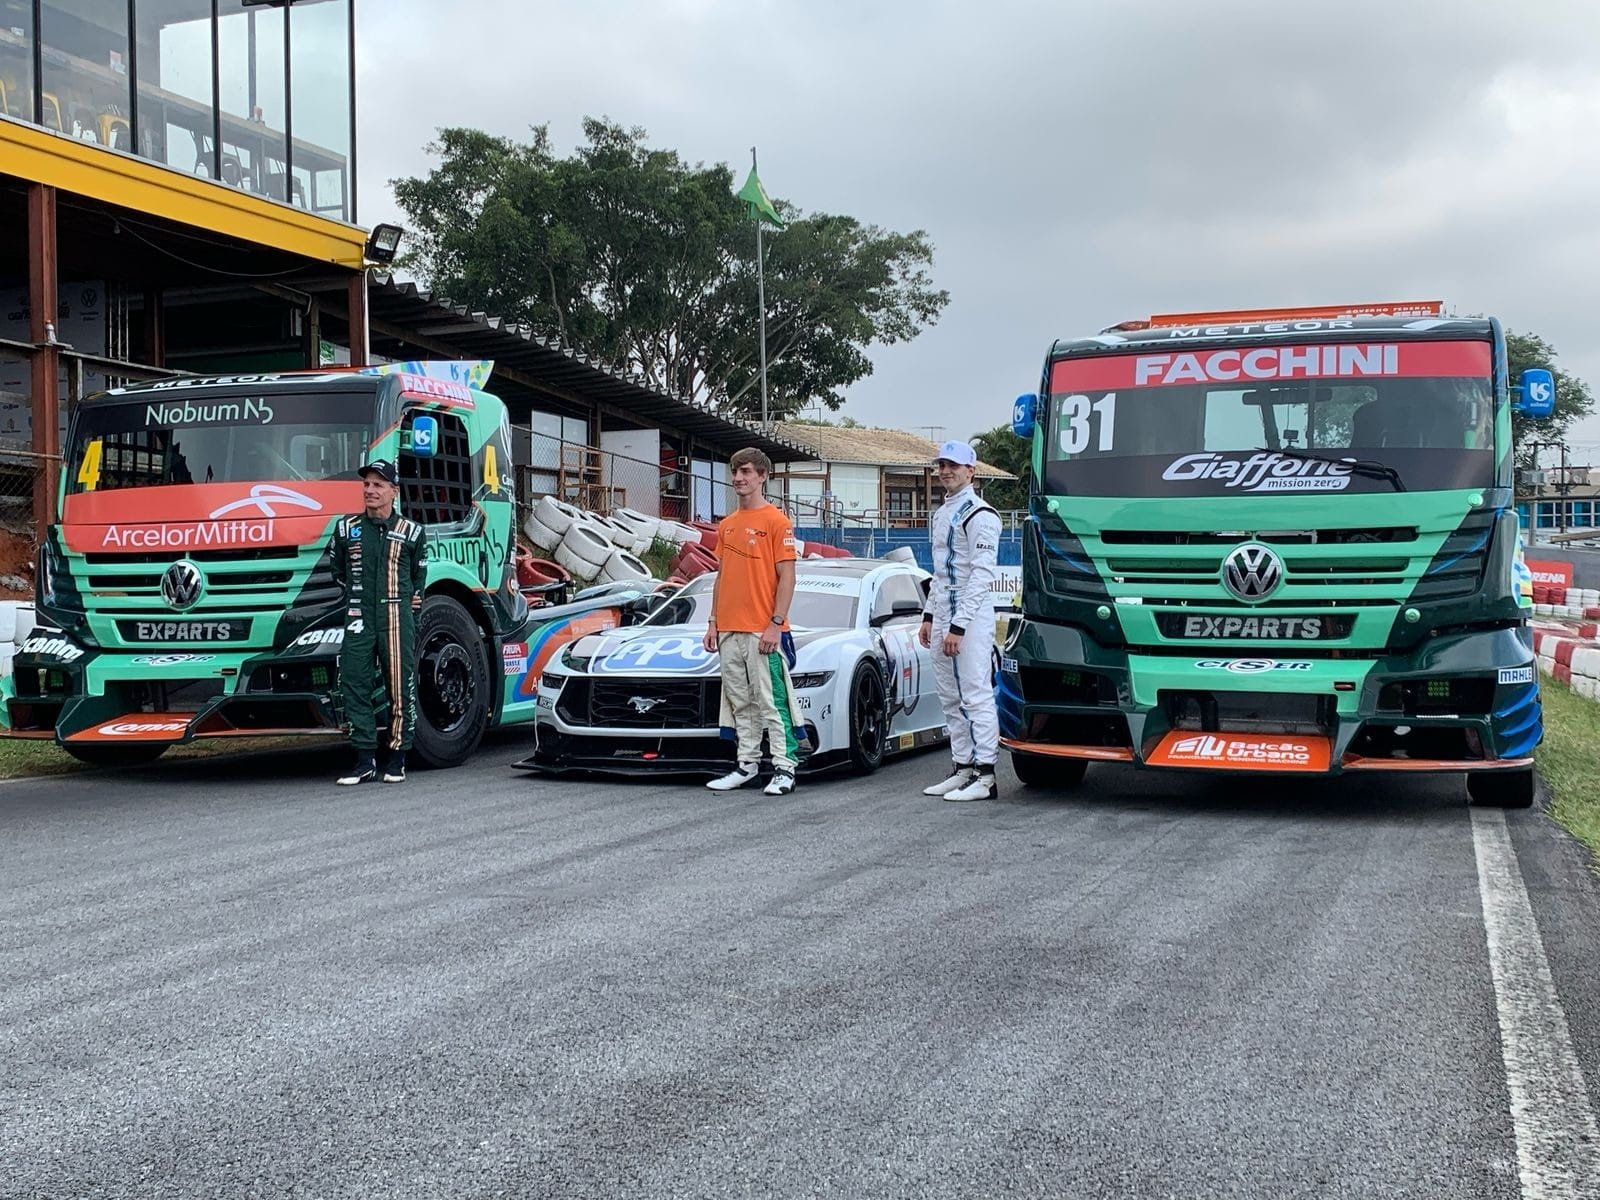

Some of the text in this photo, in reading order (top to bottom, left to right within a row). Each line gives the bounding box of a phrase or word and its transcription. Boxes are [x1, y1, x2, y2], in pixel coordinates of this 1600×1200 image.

[1170, 320, 1354, 338] METEOR
[1135, 344, 1400, 386] FACCHINI
[153, 374, 282, 389] METEOR
[145, 400, 239, 426] Niobium
[1060, 392, 1117, 455] 31
[78, 440, 103, 491] 4
[484, 445, 499, 494] 4
[1162, 452, 1357, 487] Giaffone
[1267, 478, 1342, 489] mission zero
[102, 519, 274, 547] ArcelorMittal
[137, 622, 231, 640] EXPARTS
[347, 619, 364, 634] 4
[1184, 617, 1322, 639] EXPARTS
[297, 628, 346, 646] CBM
[1197, 659, 1312, 672] CISER
[1500, 669, 1532, 682] MAHLE
[1226, 749, 1310, 761] Urbano
[1229, 741, 1308, 752] Balcão
